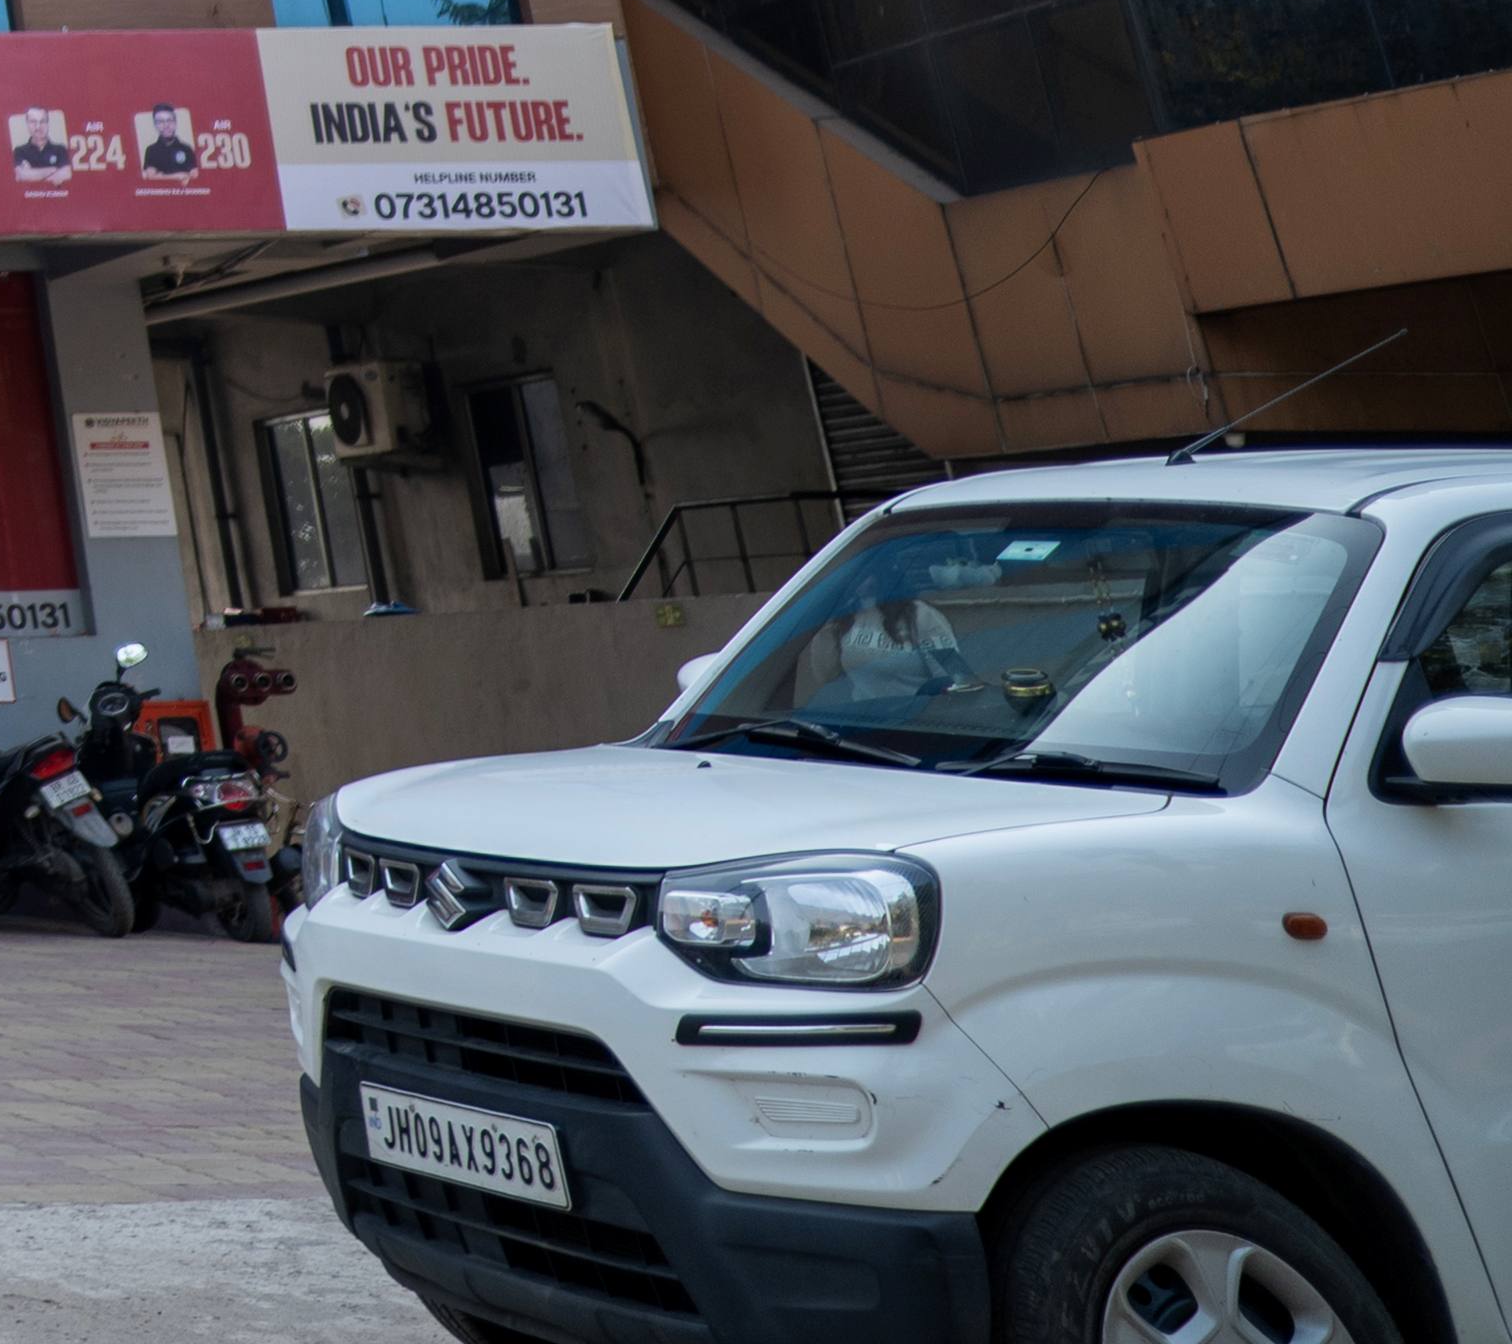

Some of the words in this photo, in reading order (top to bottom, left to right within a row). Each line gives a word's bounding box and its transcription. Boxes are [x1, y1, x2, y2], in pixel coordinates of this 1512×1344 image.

[345, 45, 415, 88] OUR
[424, 43, 530, 87] PRIDE.
[85, 121, 105, 133] AIR
[213, 119, 233, 131] AIR
[310, 100, 438, 145] INDIA'S
[445, 97, 585, 143] FUTURE.
[69, 134, 127, 173] 224
[198, 132, 252, 170] 230
[413, 171, 475, 185] HELPLINE
[478, 171, 537, 184] NUMBER
[373, 191, 590, 222] 07314850131
[383, 1104, 557, 1192] JH09AX9368
